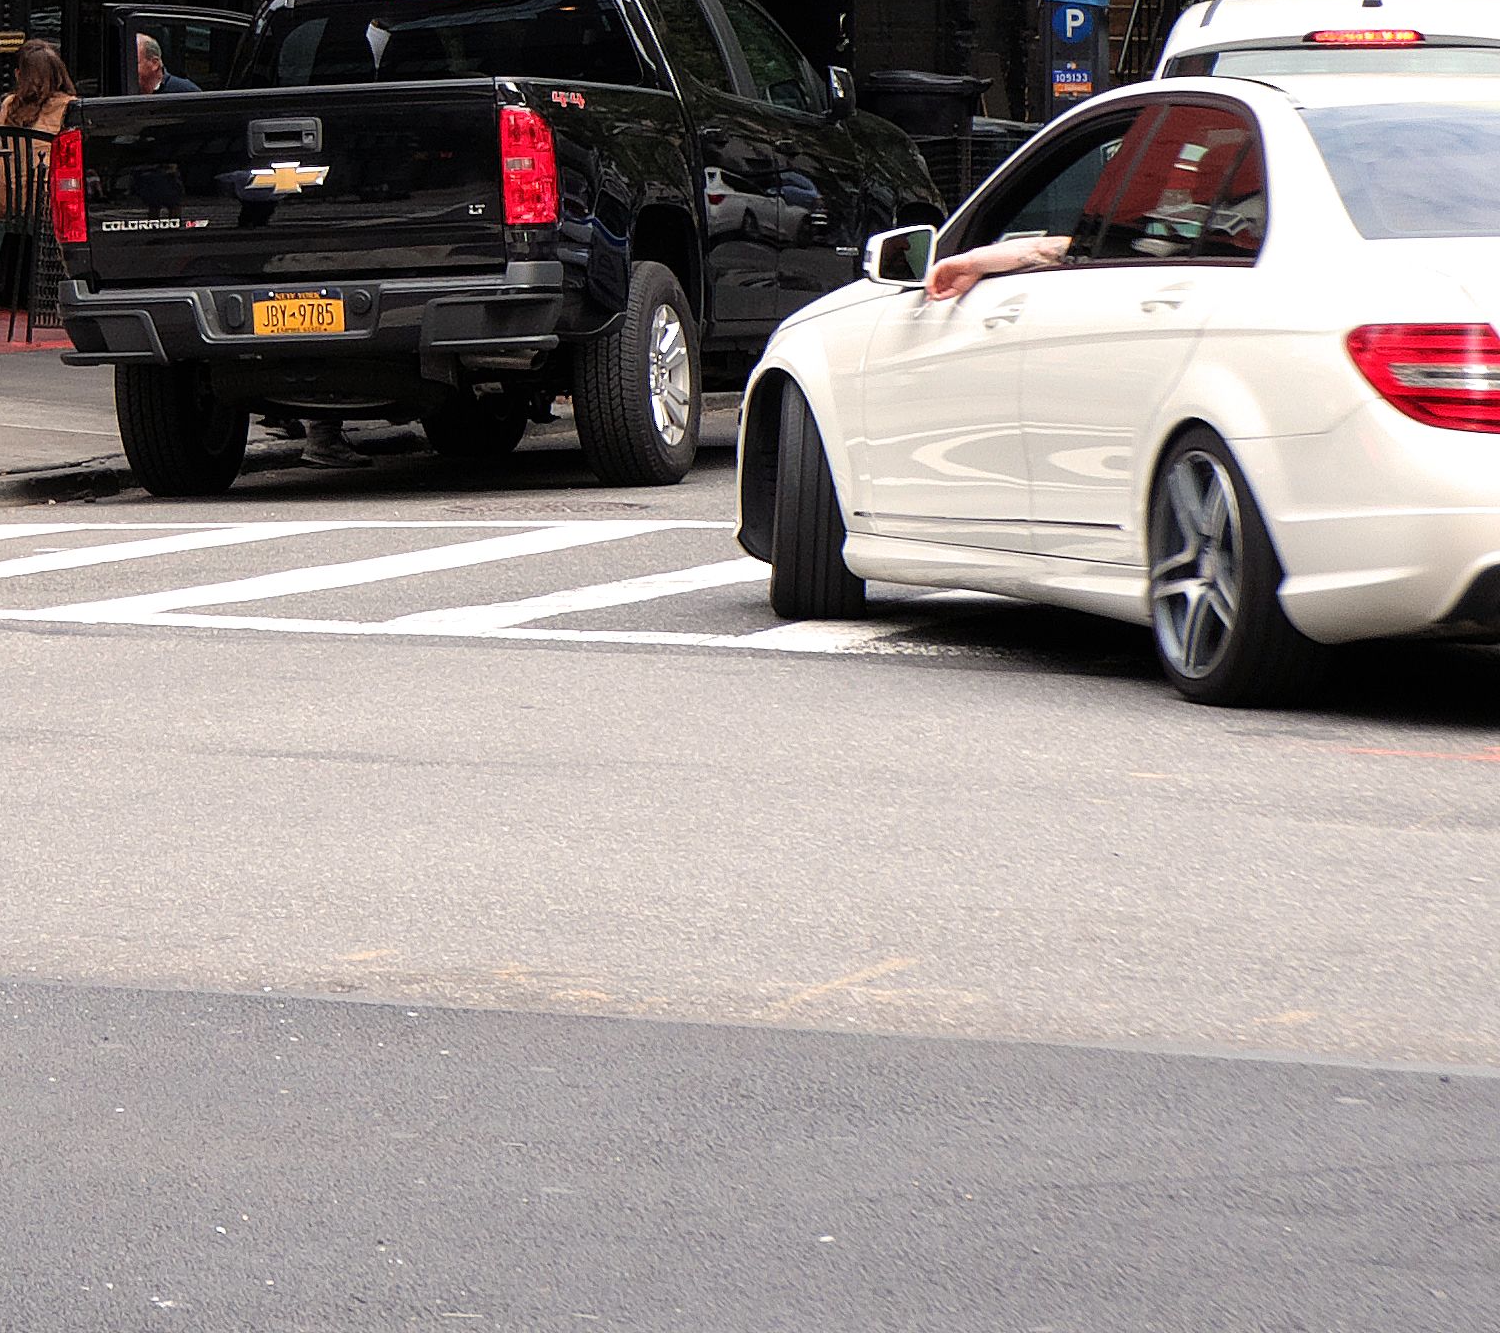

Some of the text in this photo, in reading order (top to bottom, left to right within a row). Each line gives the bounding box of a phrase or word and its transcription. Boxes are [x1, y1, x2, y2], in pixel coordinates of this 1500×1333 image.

[1065, 8, 1085, 38] P
[102, 219, 180, 231] COLORADO
[263, 303, 334, 327] JBY 9785
